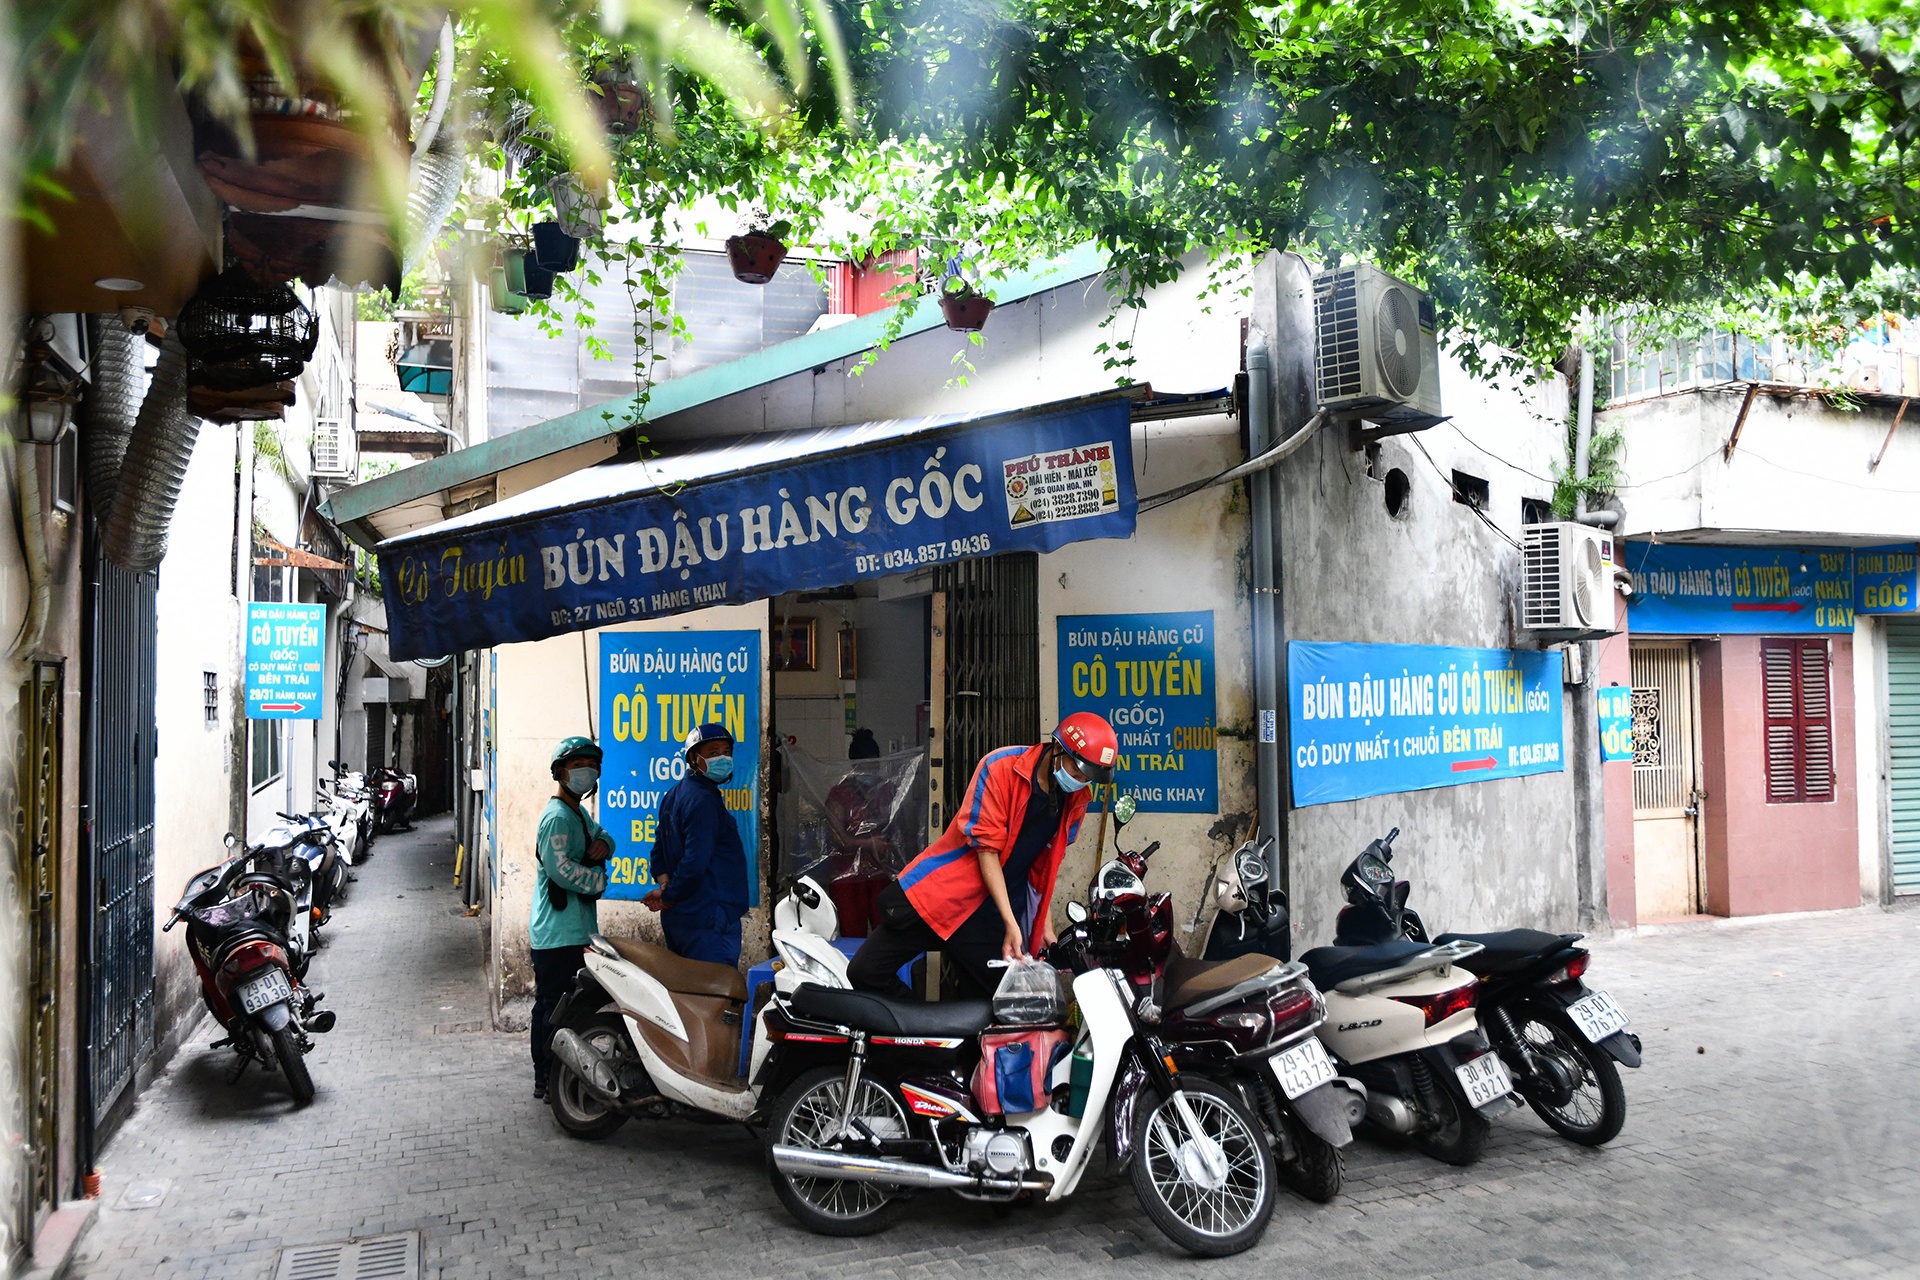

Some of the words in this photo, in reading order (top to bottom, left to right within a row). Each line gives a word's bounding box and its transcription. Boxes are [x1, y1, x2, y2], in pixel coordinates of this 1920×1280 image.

[1005, 455, 1040, 478] PHÚ
[1045, 446, 1110, 469] THÀNH
[1029, 473, 1042, 486] MÁI
[1044, 471, 1061, 483] HIÊN
[1068, 469, 1082, 481] MÁI
[1084, 462, 1098, 476] XẾP
[1030, 498, 1050, 511] (024)
[1052, 488, 1099, 506] 3828.7390
[1034, 487, 1045, 495] 265
[1047, 484, 1065, 494] QUAN
[1083, 480, 1093, 488] HN
[541, 528, 625, 590] BÚN
[636, 509, 728, 580] ĐẬU
[739, 488, 872, 553] HÀNG
[886, 447, 983, 525] GỐC
[1035, 510, 1053, 522] (024)
[1055, 501, 1100, 518] 2232.8888
[856, 554, 880, 573] ĐT:
[884, 534, 991, 568] 034.857.9436
[1820, 554, 1845, 573] DUY
[1858, 554, 1883, 574] BÚN
[1887, 550, 1913, 576] ĐẬU
[441, 541, 526, 600] Tuyến
[1631, 568, 1647, 594] ÚN
[1650, 567, 1676, 600] ĐẬU
[1679, 565, 1713, 596] HÀNG
[1715, 563, 1732, 597] CŨ
[1734, 561, 1751, 597] CÔ
[1752, 555, 1791, 598] TUYẾN
[1791, 582, 1812, 597] (GỐC)
[1815, 574, 1850, 599] NHẤT
[1864, 577, 1908, 608] GỐC
[251, 608, 267, 620] BÚN
[551, 609, 571, 626] ĐC:
[575, 606, 591, 622] 27
[596, 597, 626, 619] NGÕ
[630, 596, 647, 614] 31
[652, 589, 690, 611] HÀNG
[693, 582, 727, 603] KHAY
[1815, 599, 1825, 627] Ở
[1828, 604, 1854, 627] ĐÂY
[252, 621, 271, 646] CÔ
[274, 620, 318, 647] TUYẾN
[1068, 627, 1098, 647] BÚN
[1101, 627, 1133, 651] ĐẬU
[1137, 626, 1179, 645] HÀNG
[1183, 624, 1204, 644] CŨ
[248, 662, 259, 672] CÓ
[260, 664, 276, 672] DUY
[277, 662, 296, 672] NHẤT
[298, 664, 302, 672] 1
[270, 647, 299, 661] (GỐC)
[610, 647, 640, 674] BÚN
[644, 647, 676, 680] ĐẬU
[680, 647, 723, 673] HÀNG
[727, 646, 748, 673] CŨ
[258, 672, 281, 685] BÊN
[283, 672, 309, 685] TRÁI
[1072, 654, 1107, 698] CÔ
[1115, 646, 1202, 697] TUYẾN
[250, 689, 274, 701] 29/31
[275, 690, 296, 701] HÀNG
[297, 691, 317, 701] KHAY
[1303, 676, 1343, 720] BÚN
[1349, 673, 1384, 726] ĐẬU
[1390, 668, 1433, 716] HÀNG
[1438, 664, 1458, 715] CŨ
[1462, 662, 1481, 715] CÔ
[1484, 654, 1524, 714] TUYẾN
[1525, 682, 1550, 714] (GỐC)
[613, 684, 648, 742] CÔ
[657, 676, 745, 743] TUYẾN
[1109, 700, 1165, 727] (GỐC)
[1598, 693, 1611, 719] ÚN
[1613, 692, 1631, 722] ĐẬ
[1123, 727, 1160, 746] NHẤT
[1165, 733, 1171, 746] 1
[1297, 739, 1318, 768] CÓ
[1322, 742, 1352, 765] DUY
[1356, 731, 1389, 761] NHẤT
[1393, 740, 1400, 758] 1
[1403, 725, 1440, 757] CHUỖI
[1443, 725, 1471, 754] BÊN
[1475, 722, 1503, 750] TRÁI
[649, 748, 687, 782] (GỐ
[1137, 749, 1184, 771] TRÁI
[607, 786, 627, 809] CÓ
[631, 791, 660, 809] DUY
[1167, 788, 1206, 802] KHAY
[632, 814, 660, 842] BÊ
[244, 974, 278, 997] 29-D1
[246, 985, 288, 1011] 930.36
[1575, 995, 1611, 1021] 29-D1
[894, 1037, 925, 1045] HONDA
[1278, 1043, 1316, 1074] 29-Y7
[1463, 1056, 1496, 1084] 30-H7
[1285, 1060, 1332, 1094] 443.73
[1472, 1074, 1506, 1102] 6921
